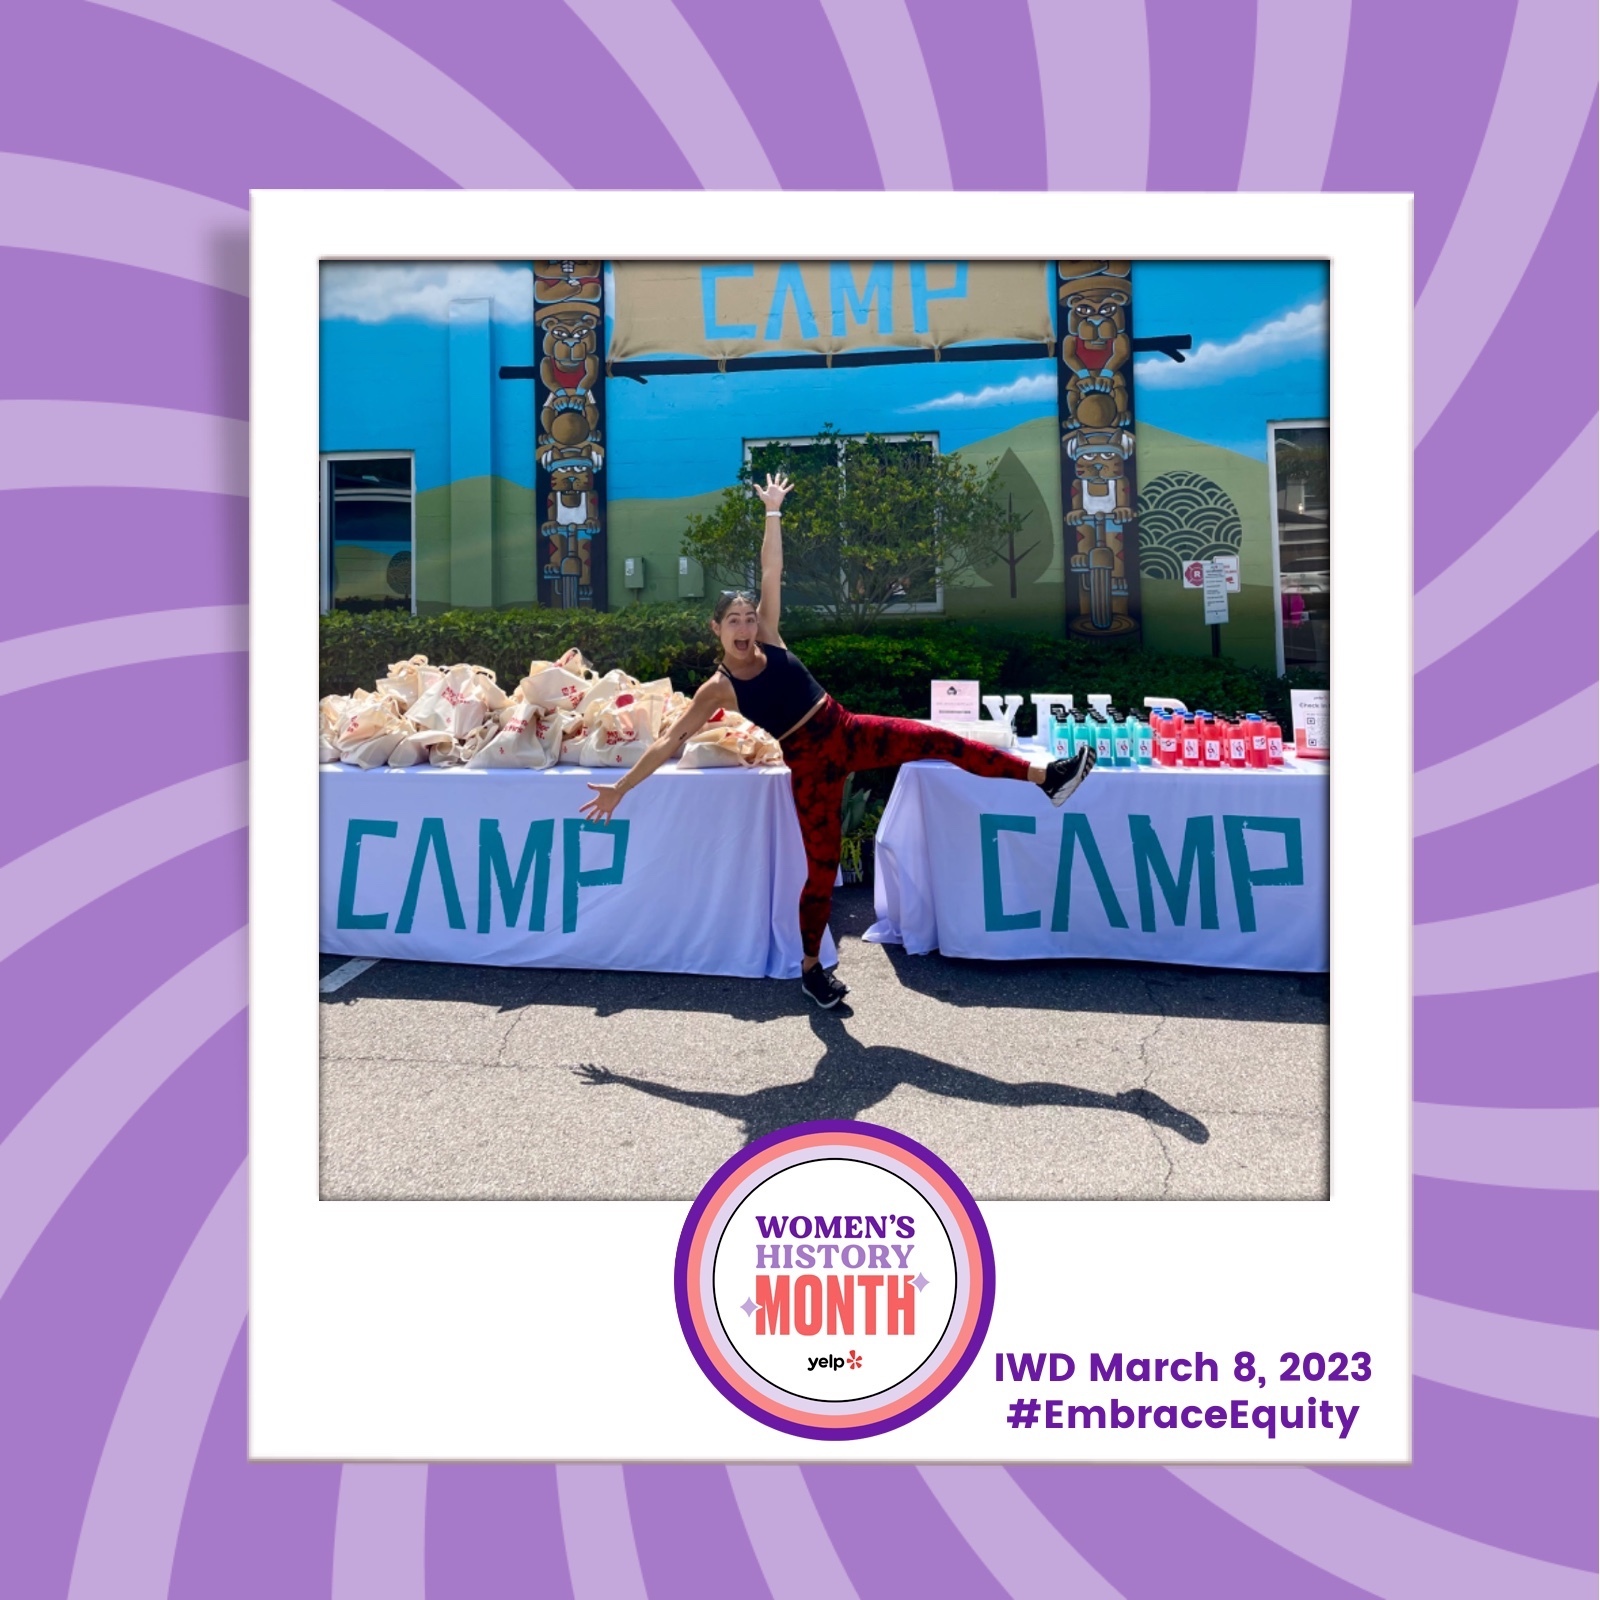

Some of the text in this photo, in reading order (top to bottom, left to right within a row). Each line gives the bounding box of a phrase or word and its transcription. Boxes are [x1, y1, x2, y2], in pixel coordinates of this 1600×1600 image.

[701, 261, 969, 341] CAMP
[1193, 570, 1201, 578] R
[336, 817, 631, 934] CAMP
[979, 813, 1304, 933] CAMP
